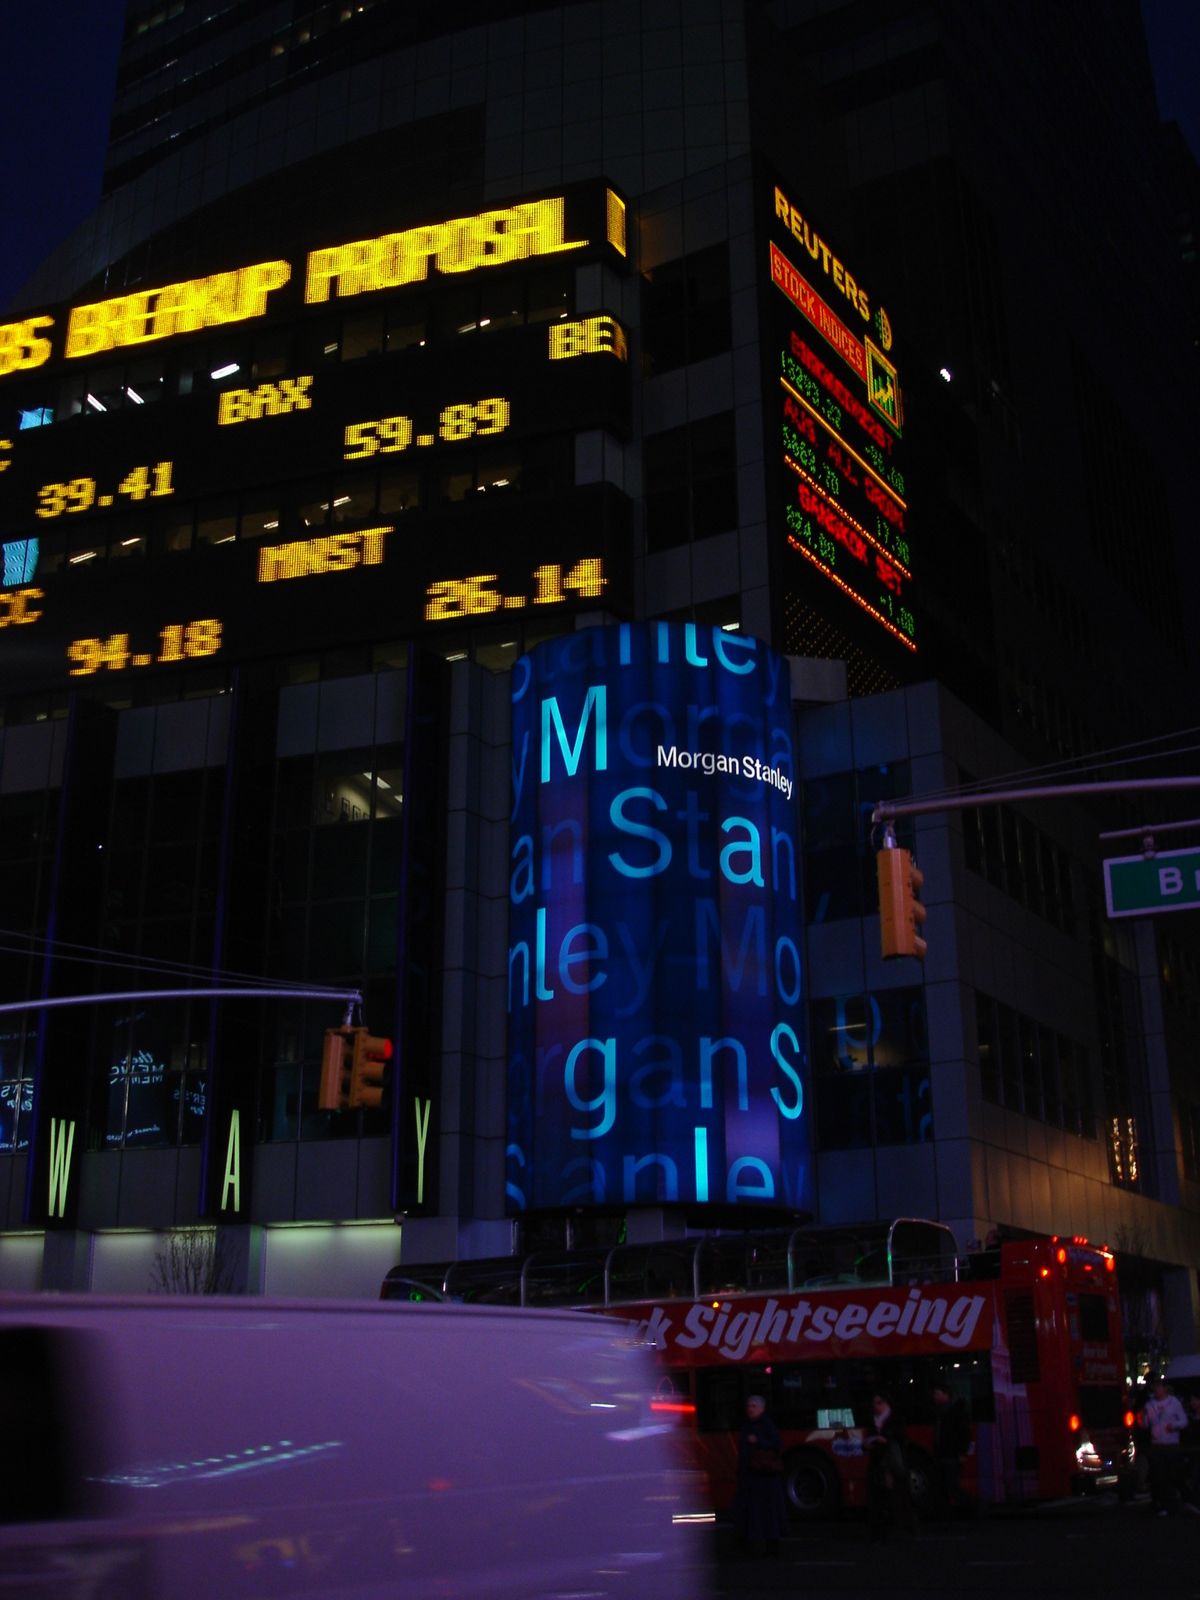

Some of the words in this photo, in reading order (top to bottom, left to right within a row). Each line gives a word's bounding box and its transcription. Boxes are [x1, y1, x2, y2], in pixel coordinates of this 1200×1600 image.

[774, 186, 870, 322] REUTERS
[773, 253, 816, 319] STOCK
[819, 303, 863, 372] INDICES
[218, 375, 313, 425] BAX
[344, 397, 510, 460] 59.89
[36, 461, 175, 518] 39.41
[426, 558, 608, 620] 26.14
[67, 619, 223, 675] 94.18
[657, 745, 739, 775] Morgan
[742, 756, 793, 800] Stanley
[1158, 866, 1200, 897] B
[674, 1289, 987, 1361] Sightseeing
